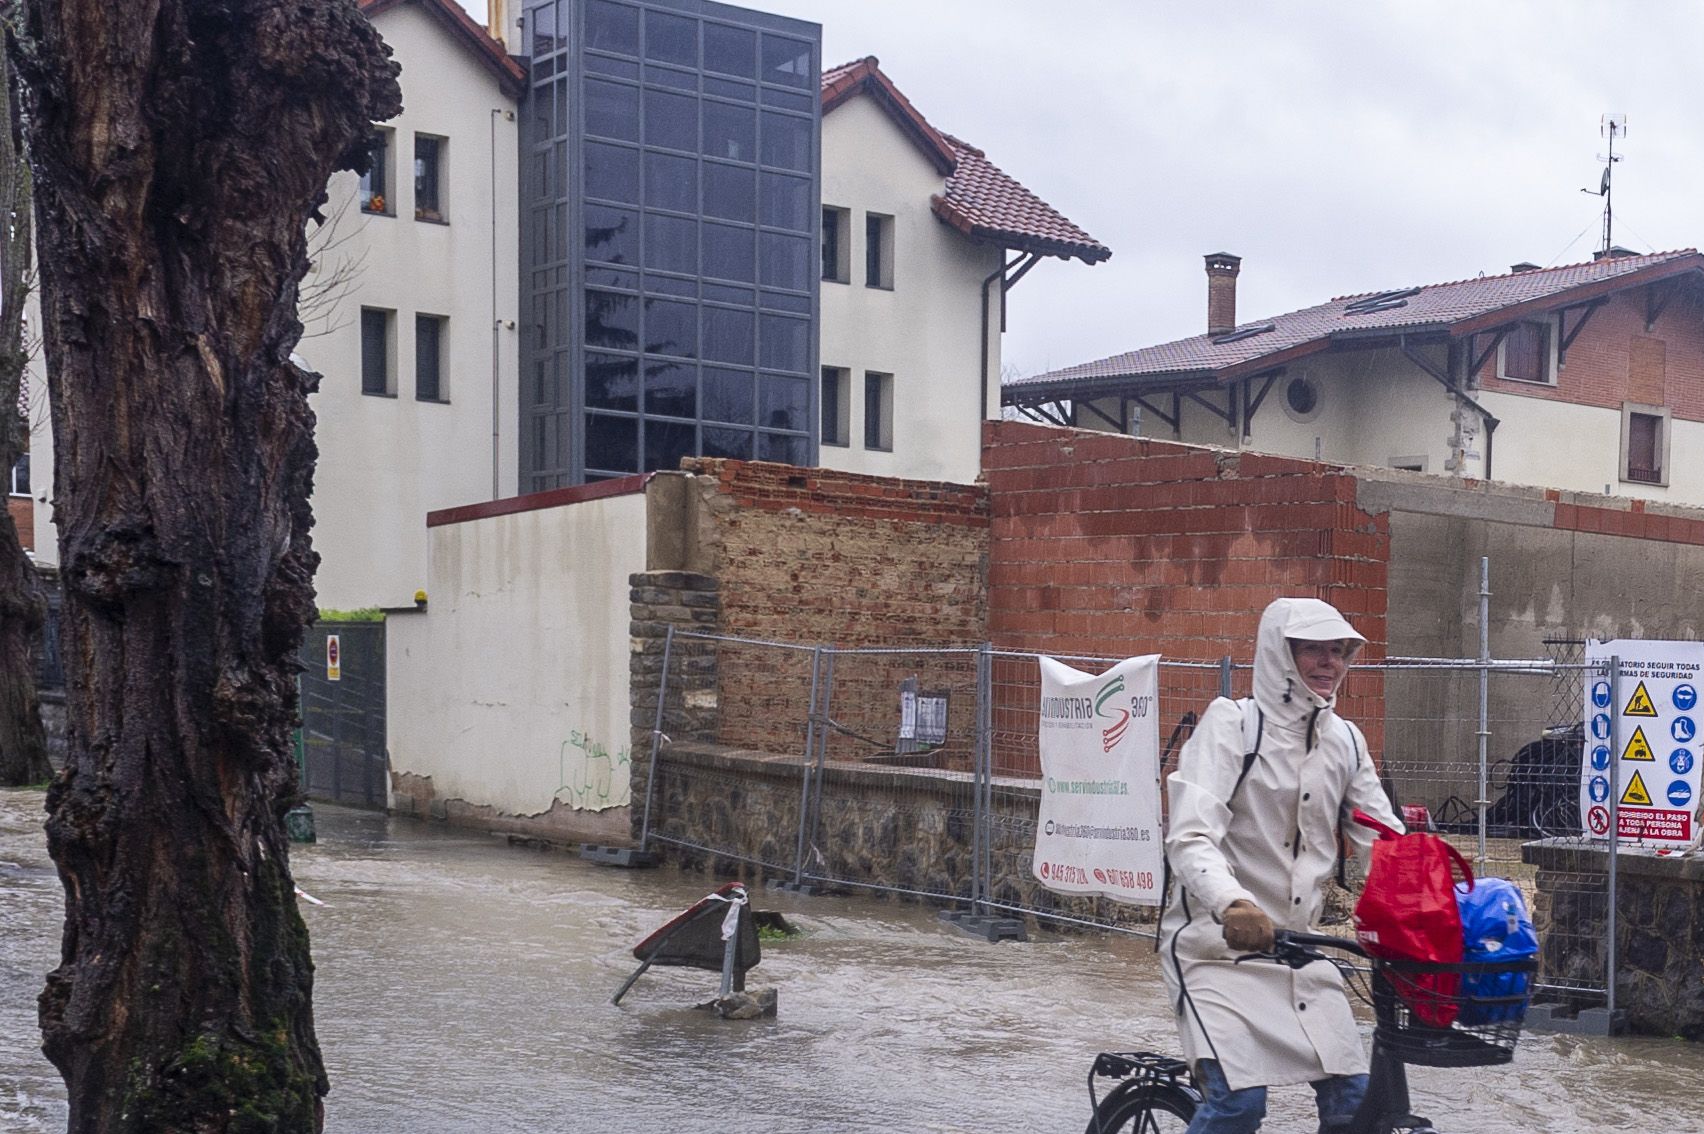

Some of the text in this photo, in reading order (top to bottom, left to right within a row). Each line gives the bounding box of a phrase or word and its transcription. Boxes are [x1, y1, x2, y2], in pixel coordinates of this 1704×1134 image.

[1647, 661, 1674, 670] SEGUIR
[1676, 663, 1700, 671] TODAS
[1640, 670, 1649, 678] DE
[1651, 671, 1693, 679] SEGURIDAD
[1666, 813, 1688, 821] PASO
[1626, 819, 1645, 827] TODA
[1646, 820, 1682, 829] PERSONA
[1661, 829, 1683, 837] OBRA
[1136, 871, 1154, 890] 498
